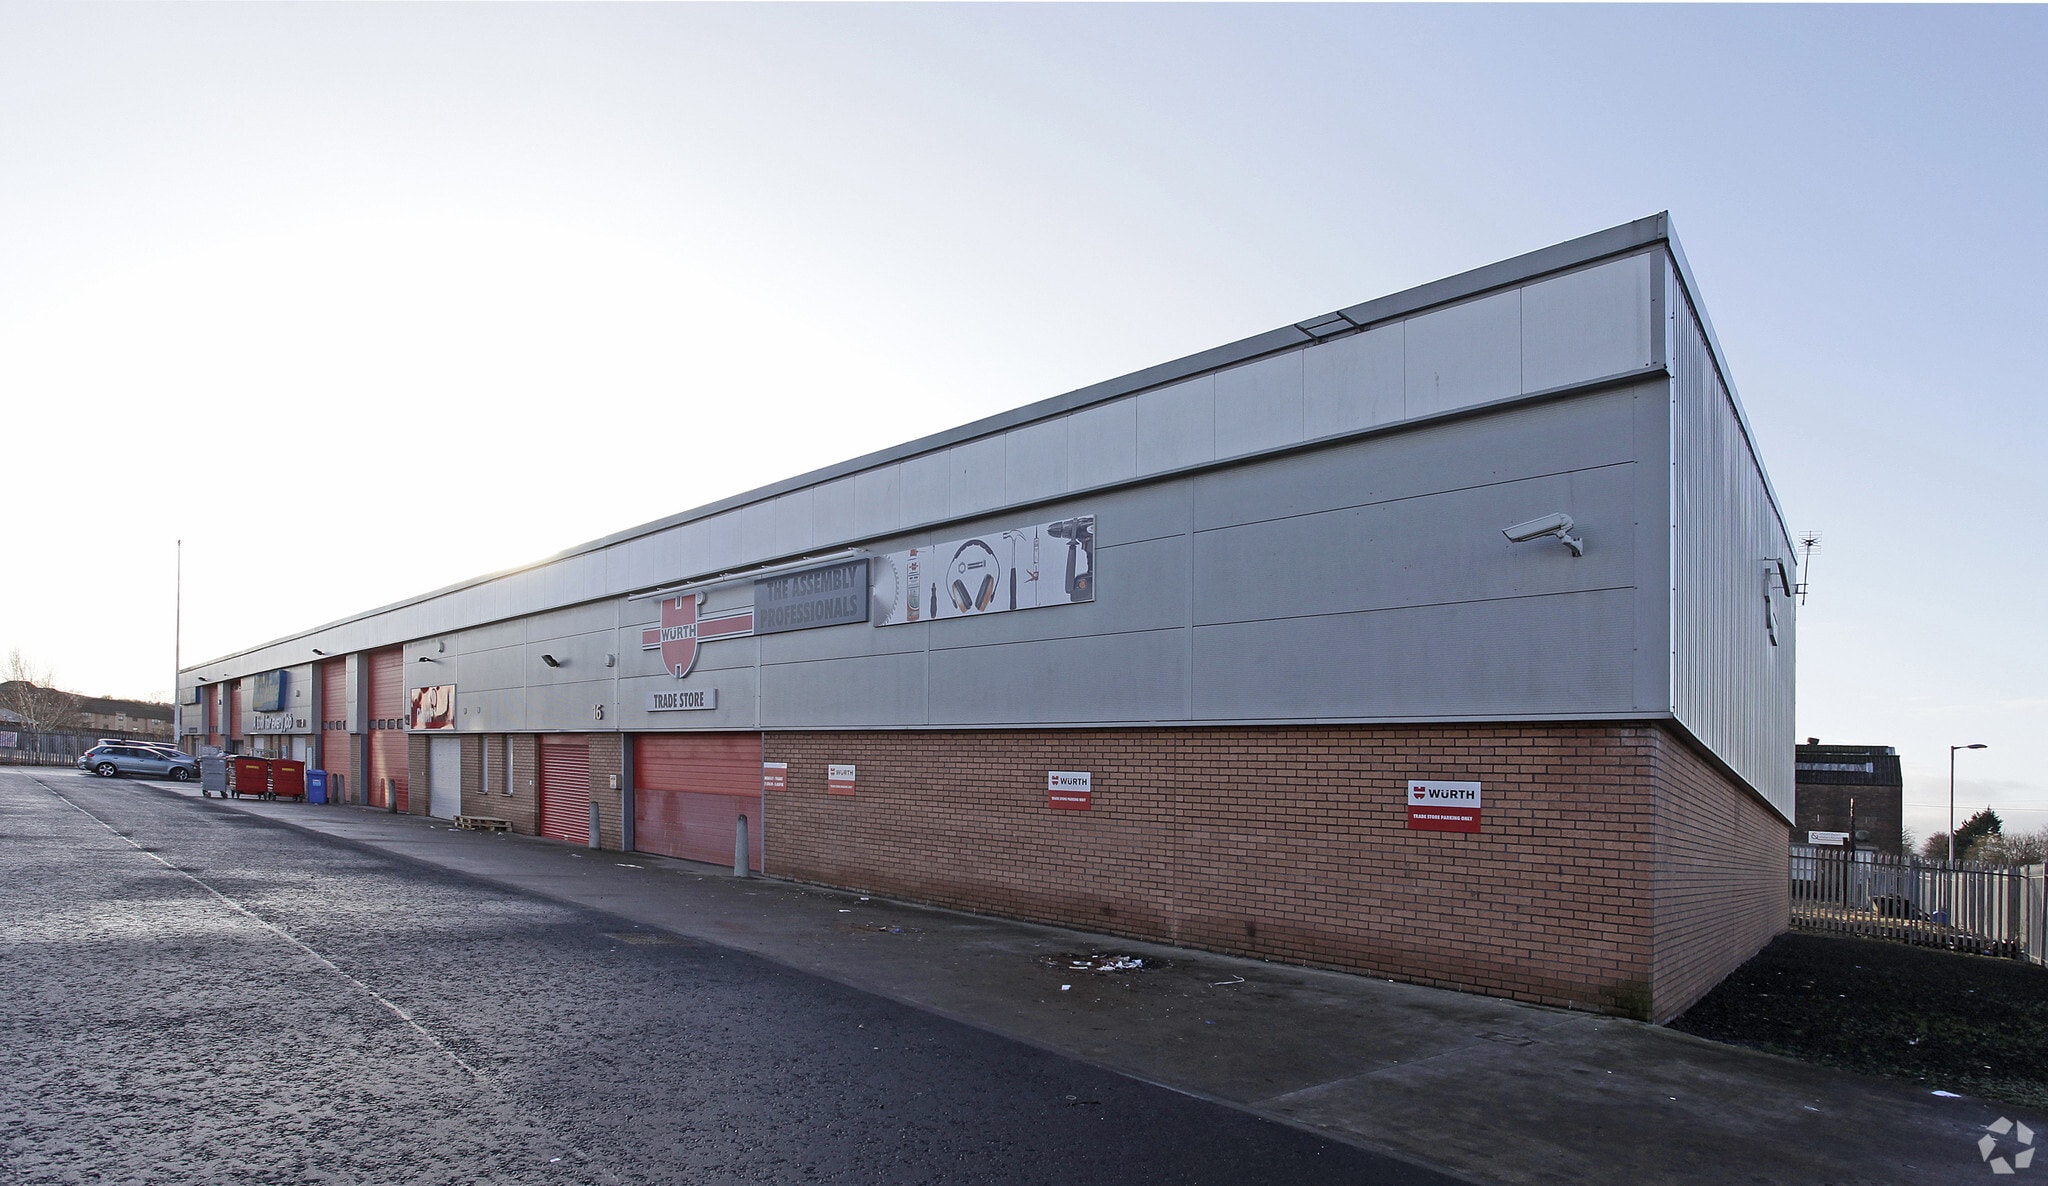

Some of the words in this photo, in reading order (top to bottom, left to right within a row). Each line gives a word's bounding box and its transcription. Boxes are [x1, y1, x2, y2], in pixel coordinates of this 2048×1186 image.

[767, 579, 788, 601] THE
[791, 566, 858, 597] ASSEMBLY
[760, 594, 858, 628] PROFESSIONALS
[661, 624, 696, 641] WÜRTH
[653, 693, 678, 709] TRADE
[679, 691, 704, 708] STORE
[1060, 777, 1087, 785] WÜRTH
[1428, 789, 1475, 799] WÜRTH
